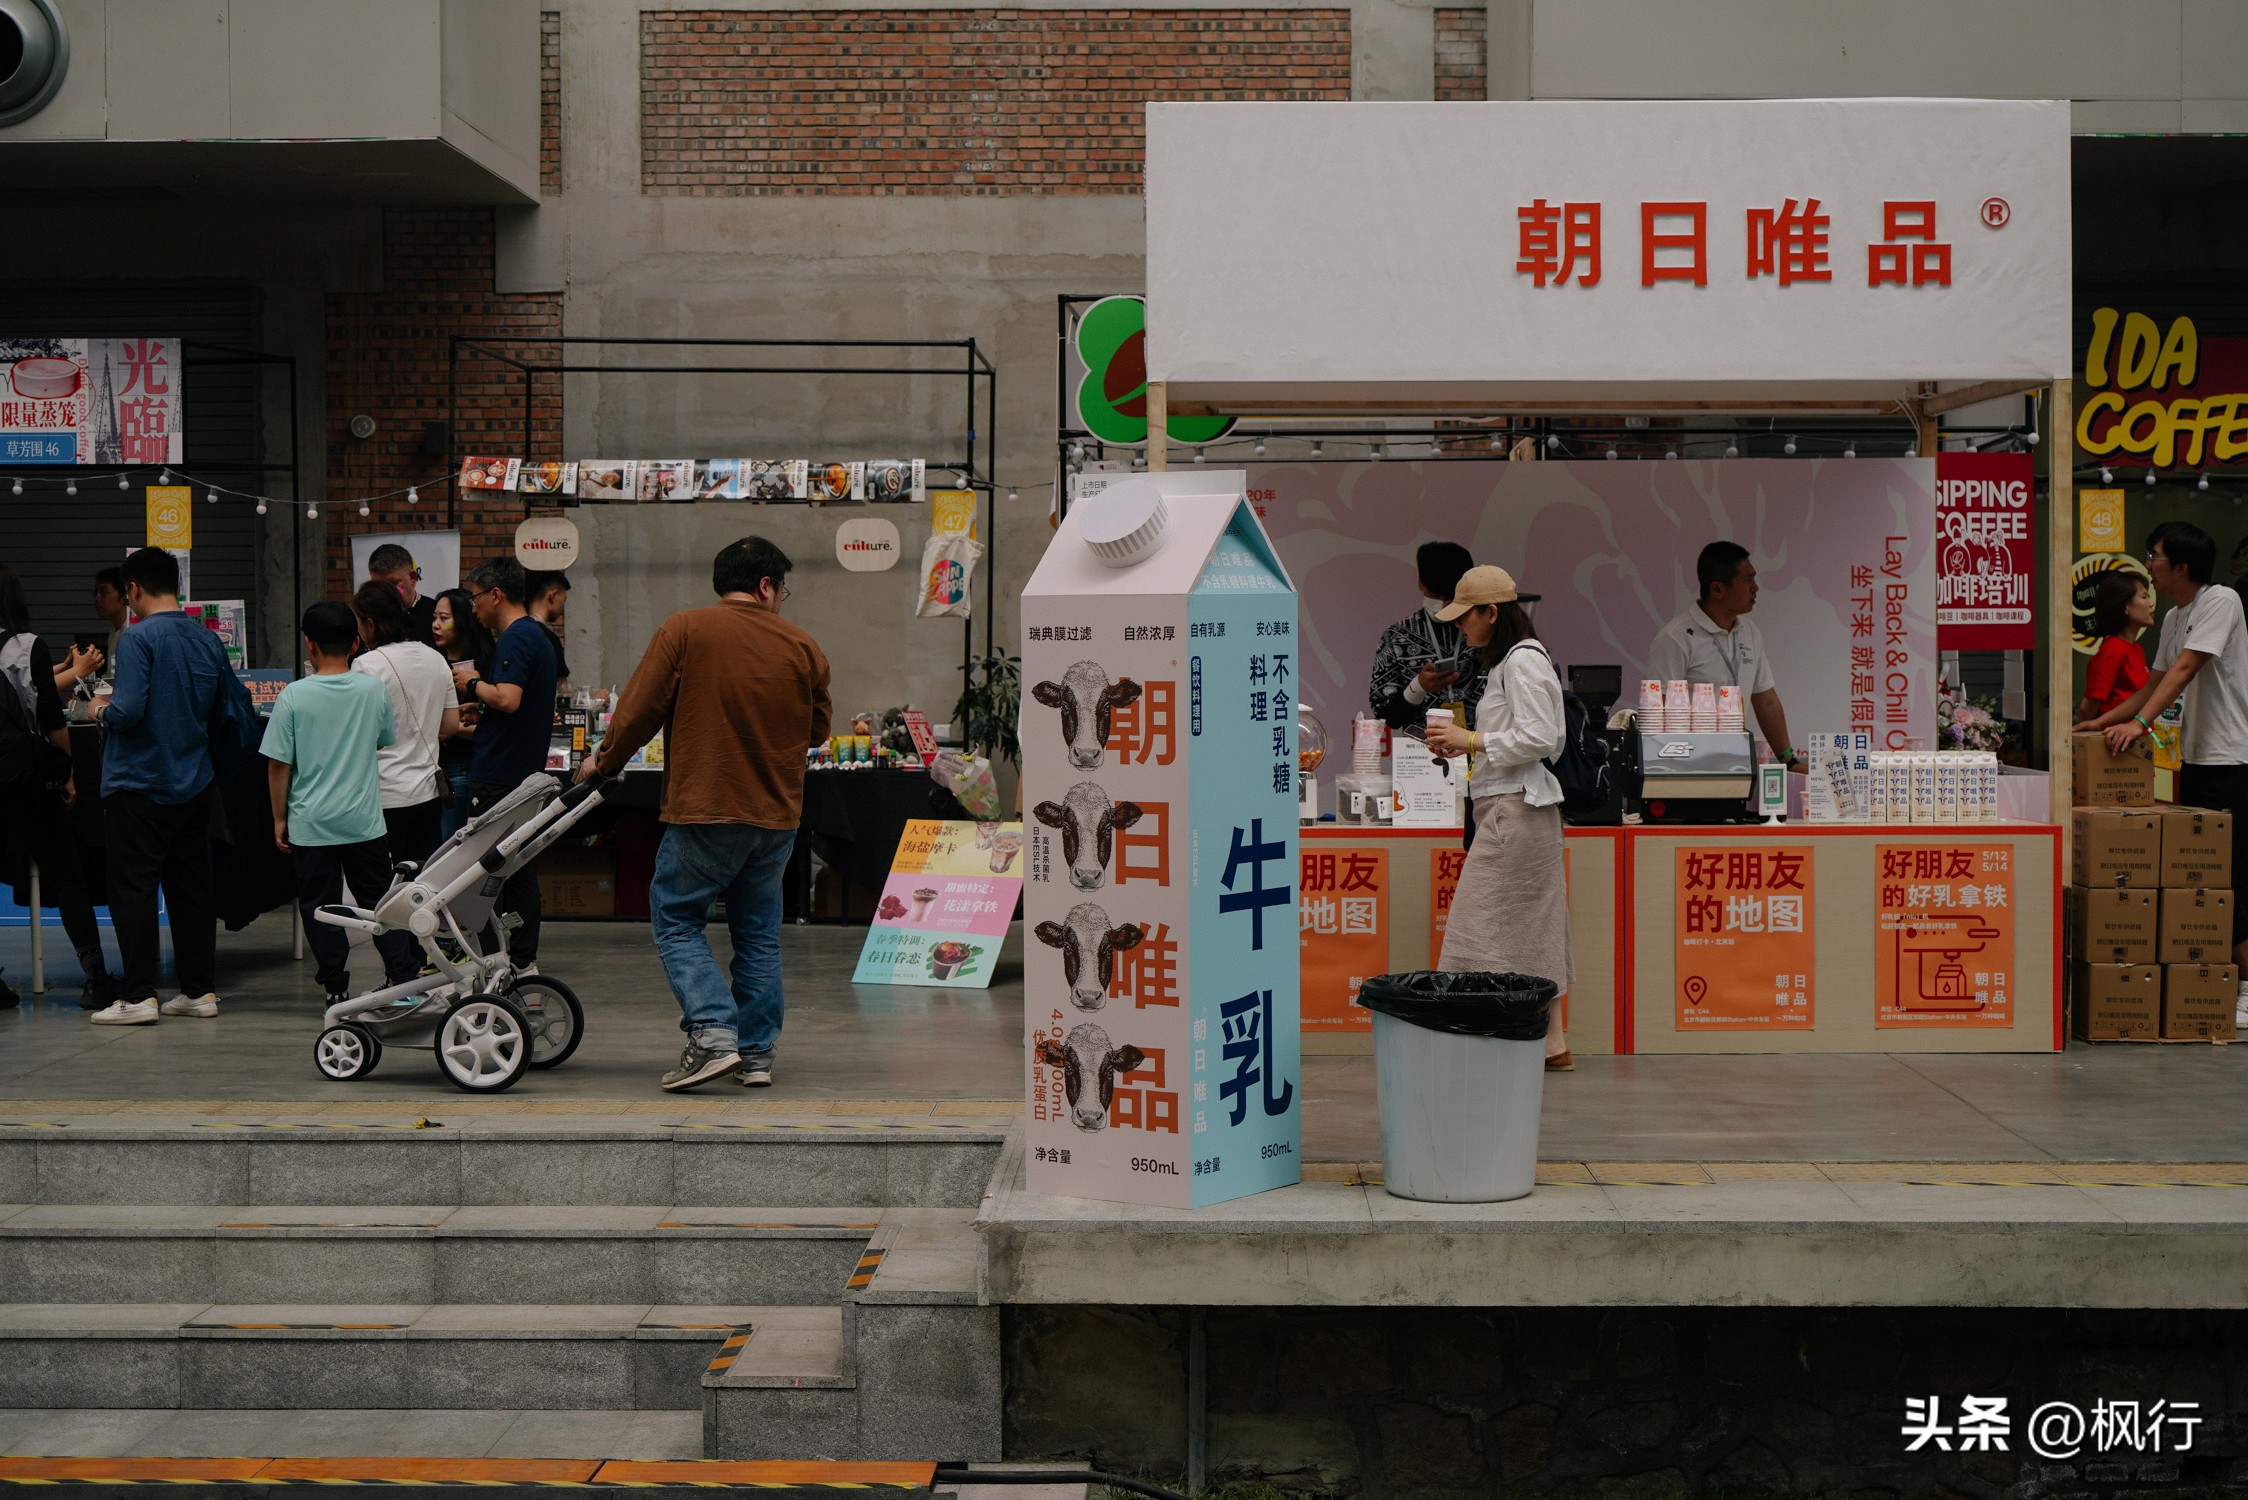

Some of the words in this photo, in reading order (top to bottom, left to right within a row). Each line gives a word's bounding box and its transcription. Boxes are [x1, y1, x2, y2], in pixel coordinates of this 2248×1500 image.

[1516, 198, 1953, 288] 朝日唯品
[2086, 307, 2197, 389] IDA
[118, 338, 168, 463] 光臨
[1, 400, 77, 429] 限量蒸笼
[6, 440, 43, 458] 草芳围
[45, 442, 59, 457] 46
[159, 509, 178, 522] 46
[944, 514, 963, 530] 47
[2091, 512, 2112, 526] 48
[522, 538, 571, 551] culture.
[843, 539, 893, 552] culture.
[1880, 536, 1908, 579] Lay
[1851, 564, 1875, 638] 坐下来
[1885, 584, 1908, 646] Back
[1938, 612, 1954, 622] 啡豆
[1029, 626, 1093, 642] 瑞典膜过滤
[1124, 626, 1176, 642] 自然浓厚
[1190, 622, 1226, 638] 自有乳源
[1256, 621, 1290, 636] 安心美味
[1885, 651, 1908, 669] &
[1249, 654, 1268, 722] 料理
[1885, 672, 1908, 723] Chill
[1272, 654, 1290, 794] 不含乳糖
[1834, 735, 1867, 750] 朝日
[903, 840, 957, 855] 海盐摩卡
[1983, 851, 2008, 861] 5/12
[1684, 851, 1805, 891] 好朋友
[1882, 850, 1975, 879] 好朋友
[1983, 862, 2008, 872] 5/14
[1883, 884, 2008, 908] 的好乳拿铁
[1106, 676, 1181, 1135] 朝日唯品
[1686, 895, 1803, 933] 的地图
[867, 951, 922, 965] 春日眷恋
[1219, 818, 1294, 1127] 牛乳
[1775, 974, 1806, 989] 朝日
[1975, 972, 2005, 987] 朝日
[1775, 993, 1807, 1006] 唯品
[1975, 990, 2006, 1004] 唯品
[1193, 1018, 1207, 1135] 朝日唯品
[1035, 1146, 1072, 1165] 净含量
[1261, 1140, 1293, 1160] 950mL
[1131, 1157, 1180, 1176] 950mL
[1194, 1156, 1221, 1177] 净含量
